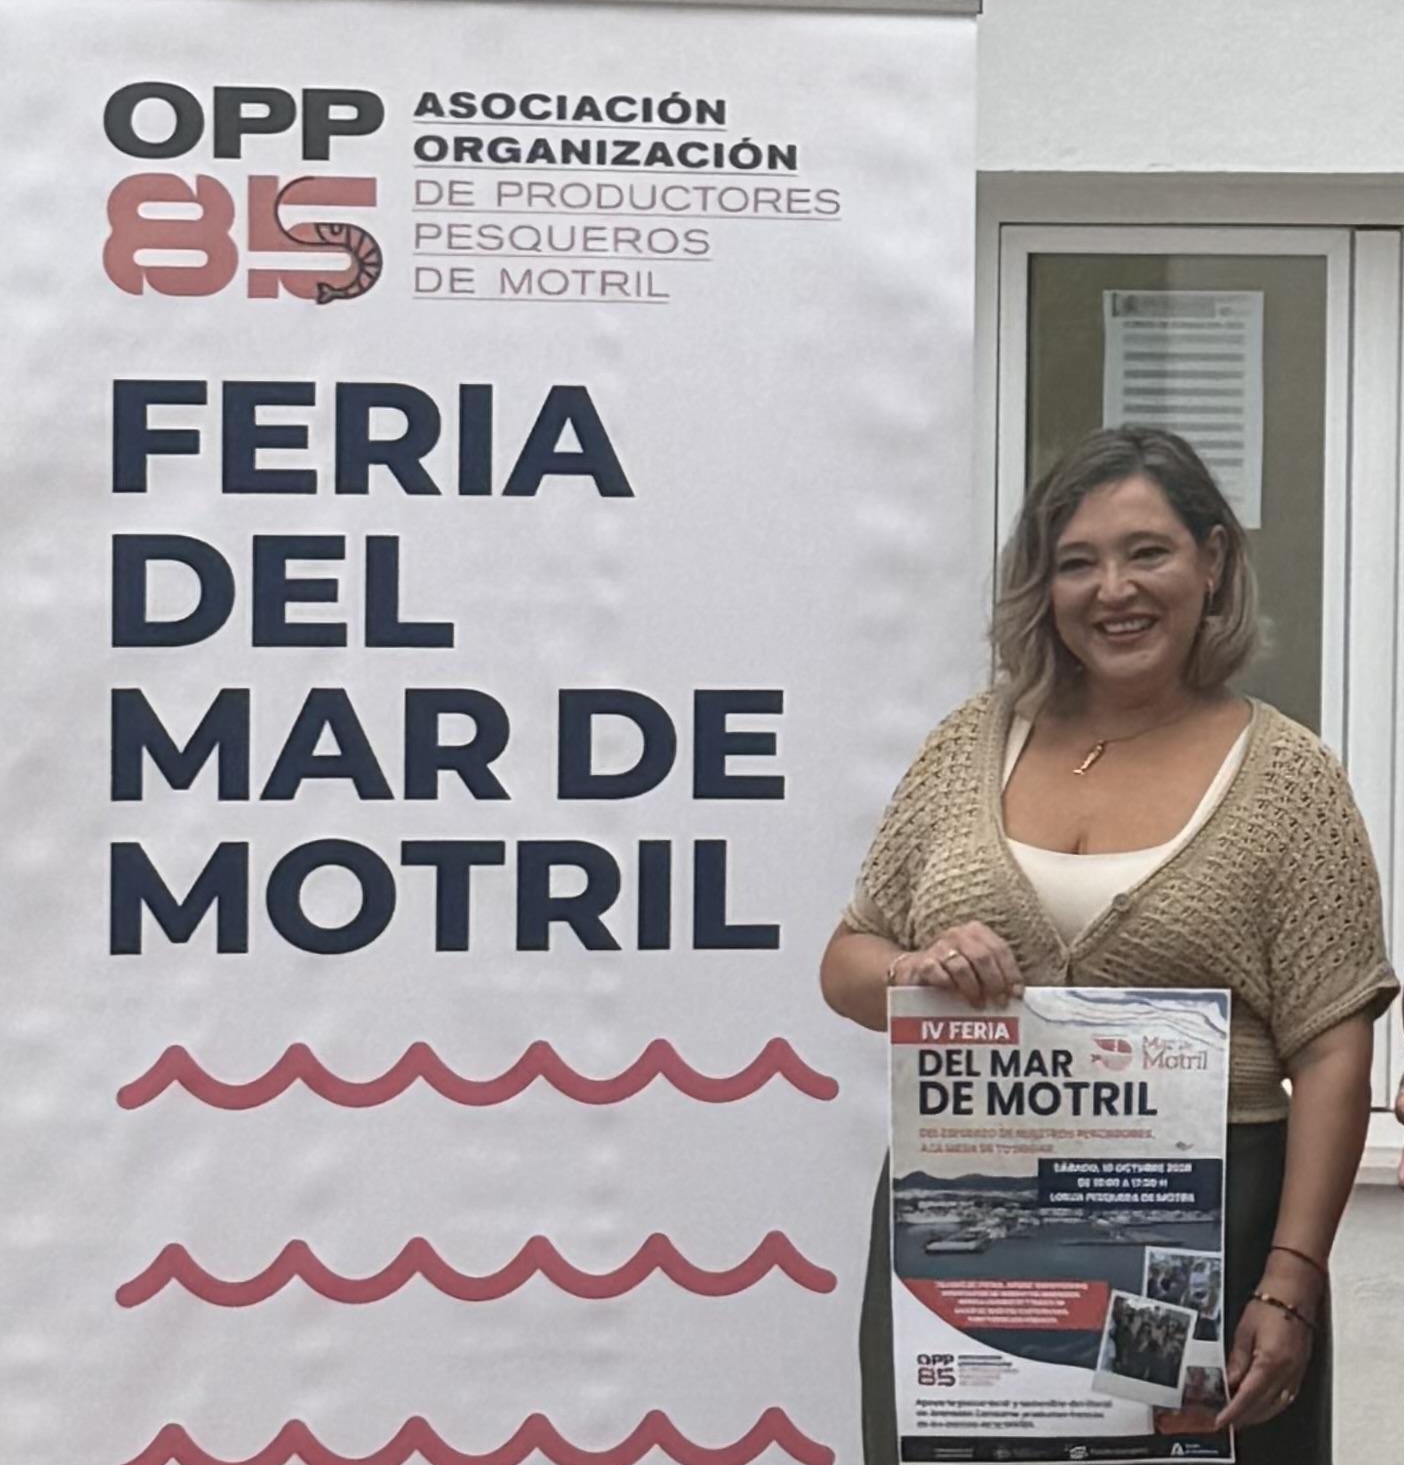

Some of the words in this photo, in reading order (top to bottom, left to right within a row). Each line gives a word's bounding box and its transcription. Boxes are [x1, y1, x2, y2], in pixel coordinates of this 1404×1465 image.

[104, 82, 384, 161] OPP
[414, 91, 727, 126] ASOCIACIÓN
[414, 135, 798, 171] ORGANIZACIÓN
[415, 179, 474, 207] DE
[497, 181, 842, 215] PRODUCTORES
[103, 173, 383, 305] 85
[415, 223, 710, 256] PESQUEROS
[415, 267, 474, 295] DE
[500, 268, 670, 298] MOTRIL
[112, 379, 634, 497] FERIA
[112, 534, 454, 648] DEL
[111, 688, 511, 801] MAR
[557, 689, 785, 800] DE
[110, 839, 780, 955] MOTRIL
[921, 1022, 941, 1040] IV
[949, 1022, 1010, 1040] FERIA
[918, 1049, 981, 1077] DEL
[990, 1050, 1073, 1077] MAR
[1142, 1050, 1208, 1070] Motril
[918, 1082, 973, 1116] DE
[987, 1082, 1158, 1116] MOTRIL
[917, 1354, 955, 1366] OPP
[918, 1367, 956, 1386] 85
